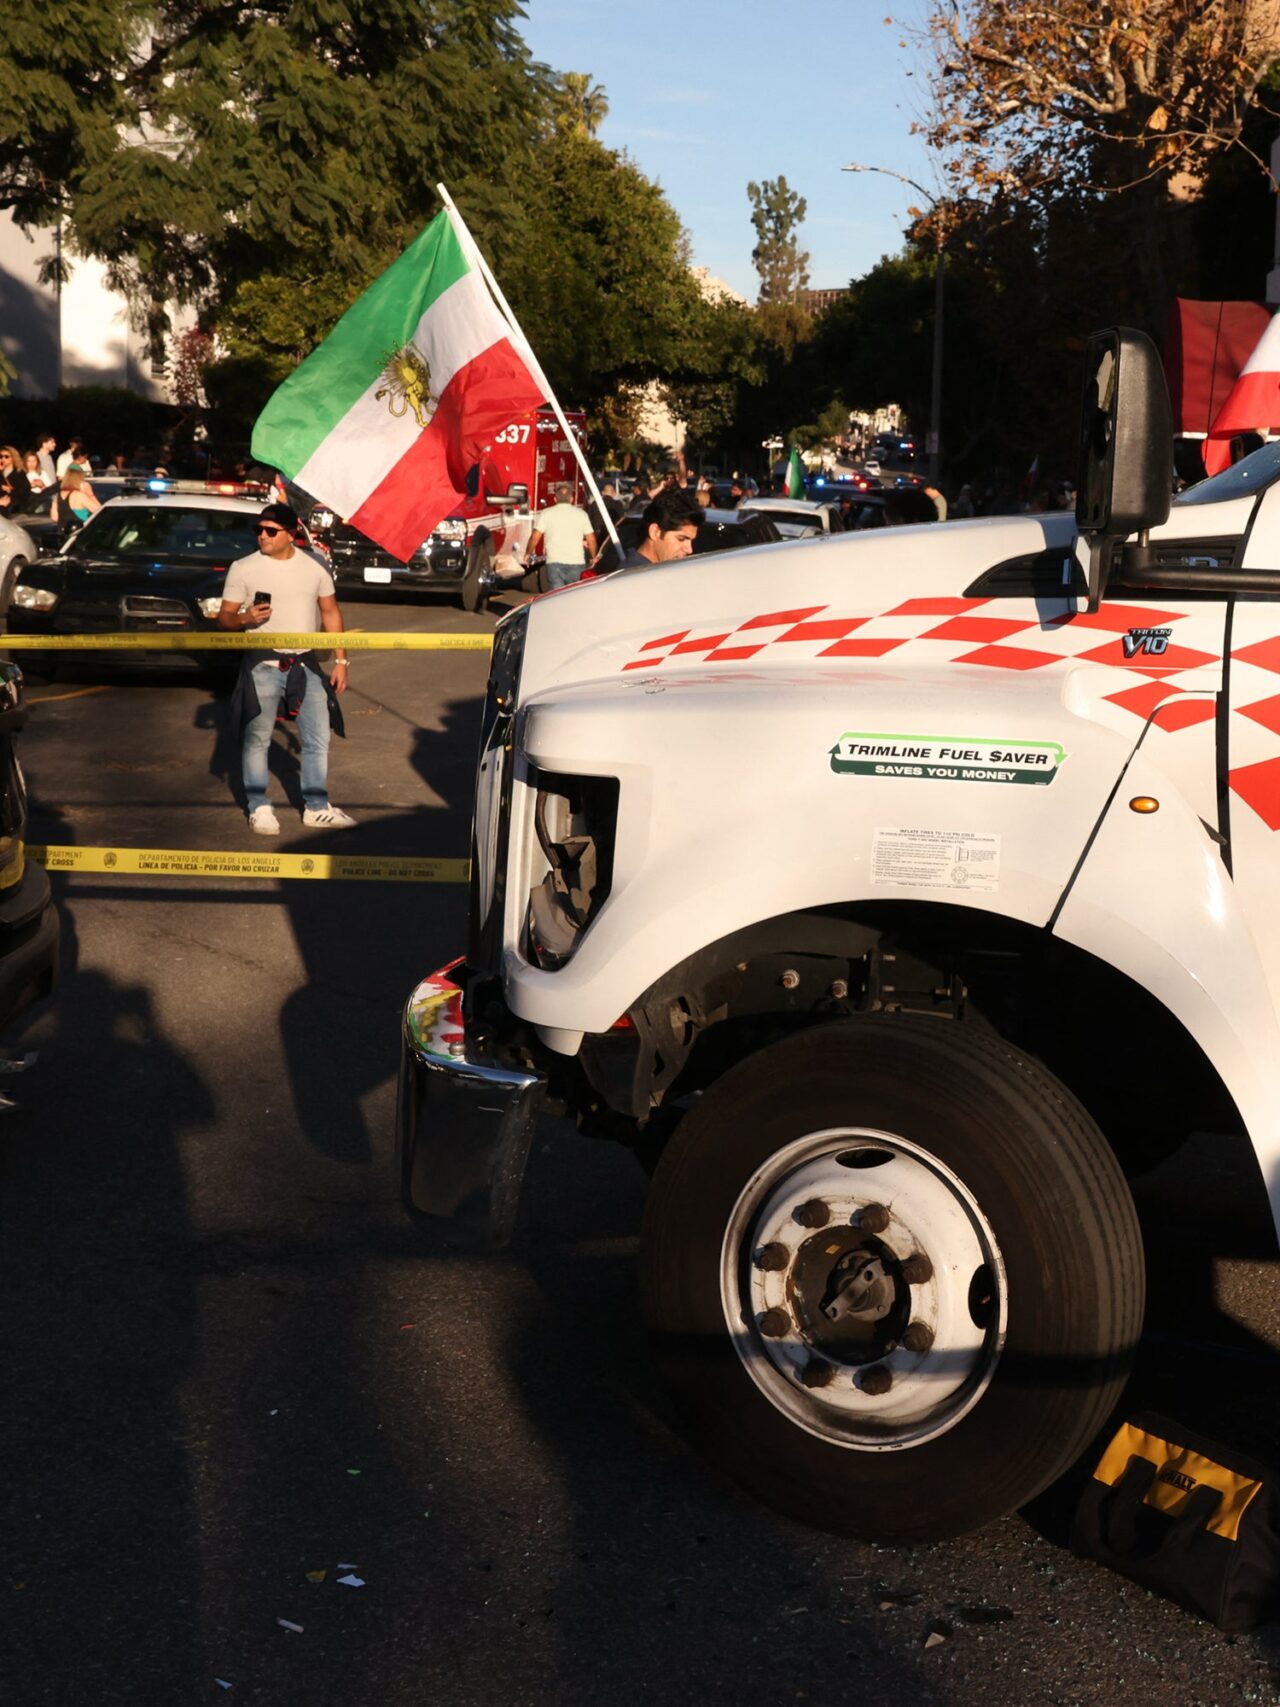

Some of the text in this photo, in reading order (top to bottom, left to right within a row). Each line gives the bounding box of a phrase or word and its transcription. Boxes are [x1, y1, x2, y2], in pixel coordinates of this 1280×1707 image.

[1122, 635, 1170, 659] V10
[848, 744, 932, 758] TRIMLINE
[939, 748, 983, 761] FUEL
[874, 764, 1017, 781] SAVES YOU MONEY
[51, 858, 75, 867] CROSS
[138, 861, 159, 869] LINEA
[160, 862, 170, 870] DE
[171, 863, 198, 871] POLICIA
[219, 864, 241, 872] FAVOR
[253, 865, 280, 873] CRUZAR
[192, 855, 199, 863] DE
[237, 857, 251, 865] LOS
